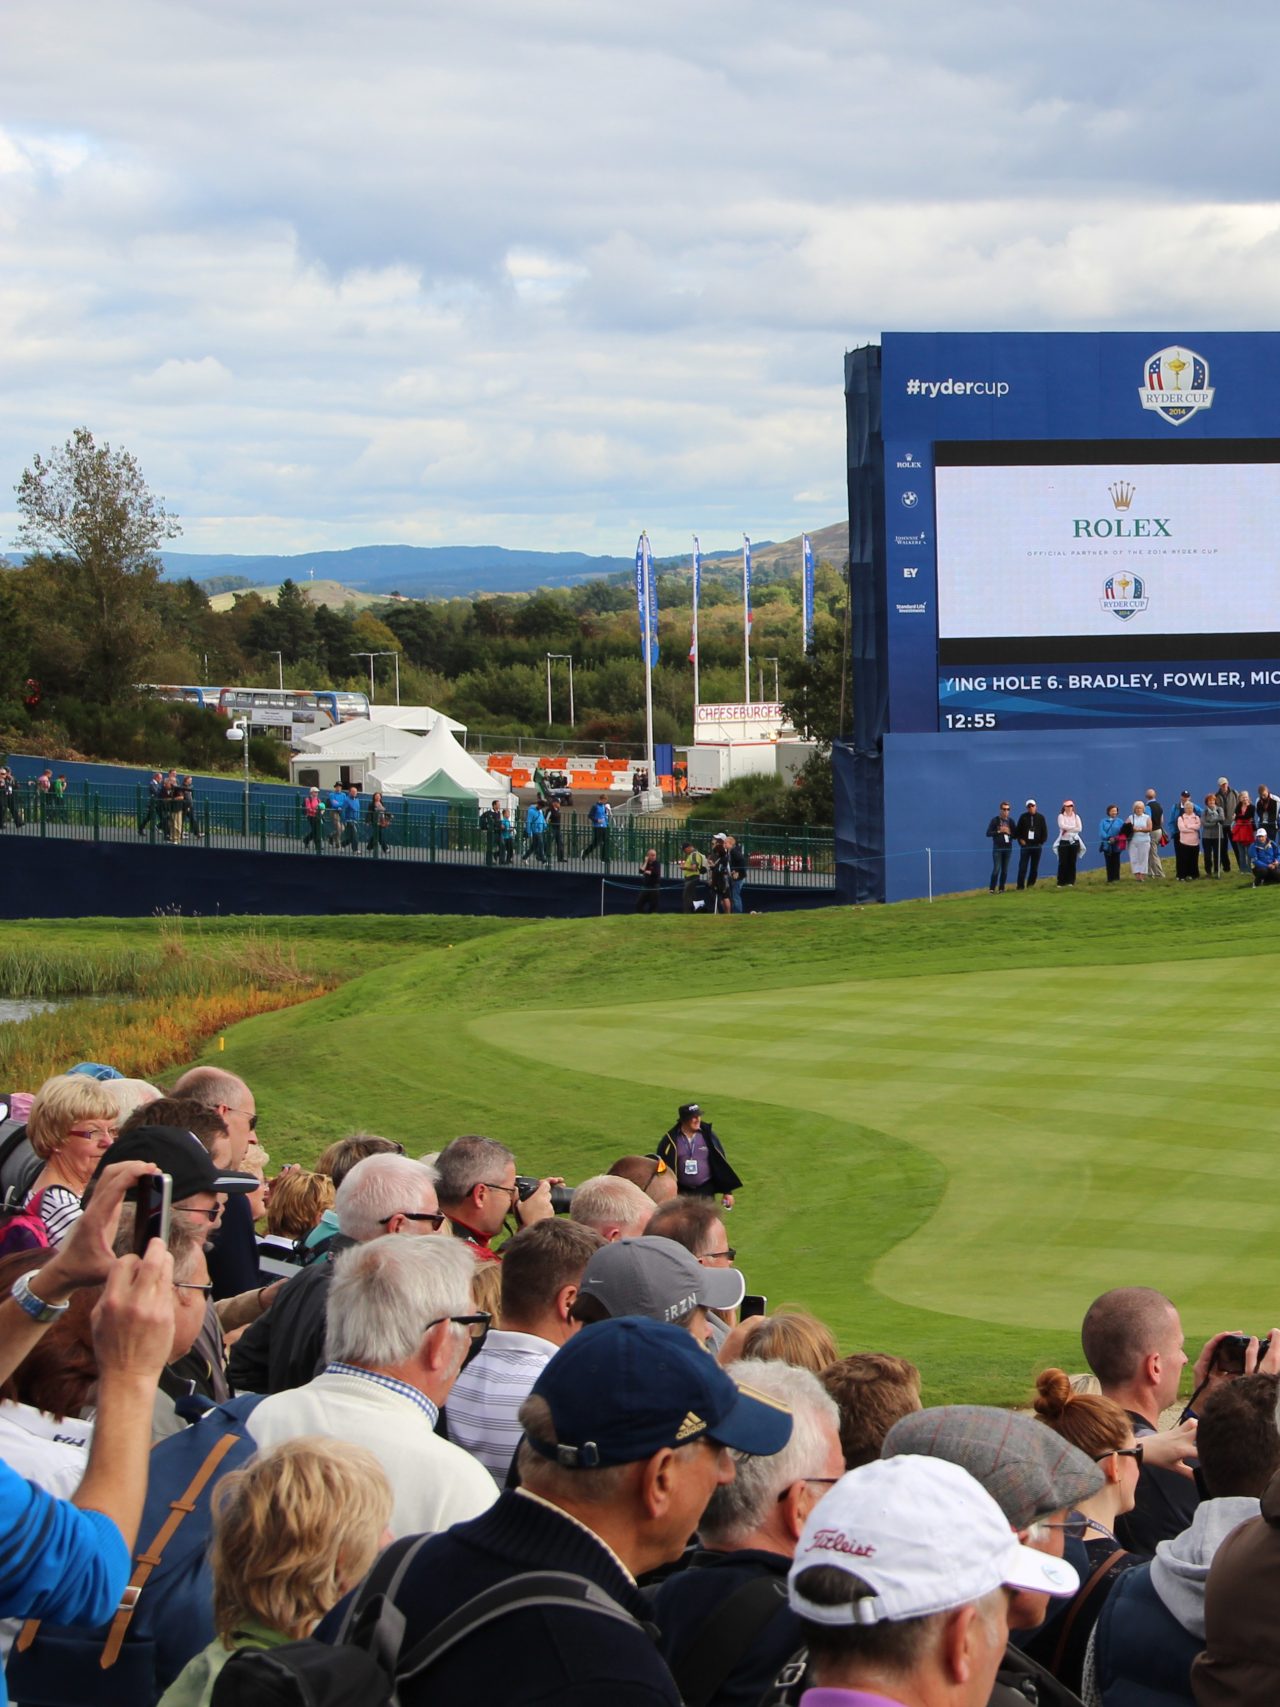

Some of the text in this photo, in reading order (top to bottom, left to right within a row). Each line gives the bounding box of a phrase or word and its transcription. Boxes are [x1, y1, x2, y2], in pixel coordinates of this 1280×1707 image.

[906, 378, 1010, 398] #rydercup
[1146, 393, 1208, 403] RYDER CUP
[1072, 518, 1173, 538] ROLEX
[903, 568, 918, 578] EY
[993, 676, 1042, 690] HOLE
[1047, 676, 1063, 690] 6.
[1068, 674, 1158, 690] BRADLEY,
[1163, 672, 1245, 688] FOWLER,
[946, 713, 996, 729] 12:55
[675, 1420, 708, 1440] adidas
[804, 1529, 877, 1558] Titleist
